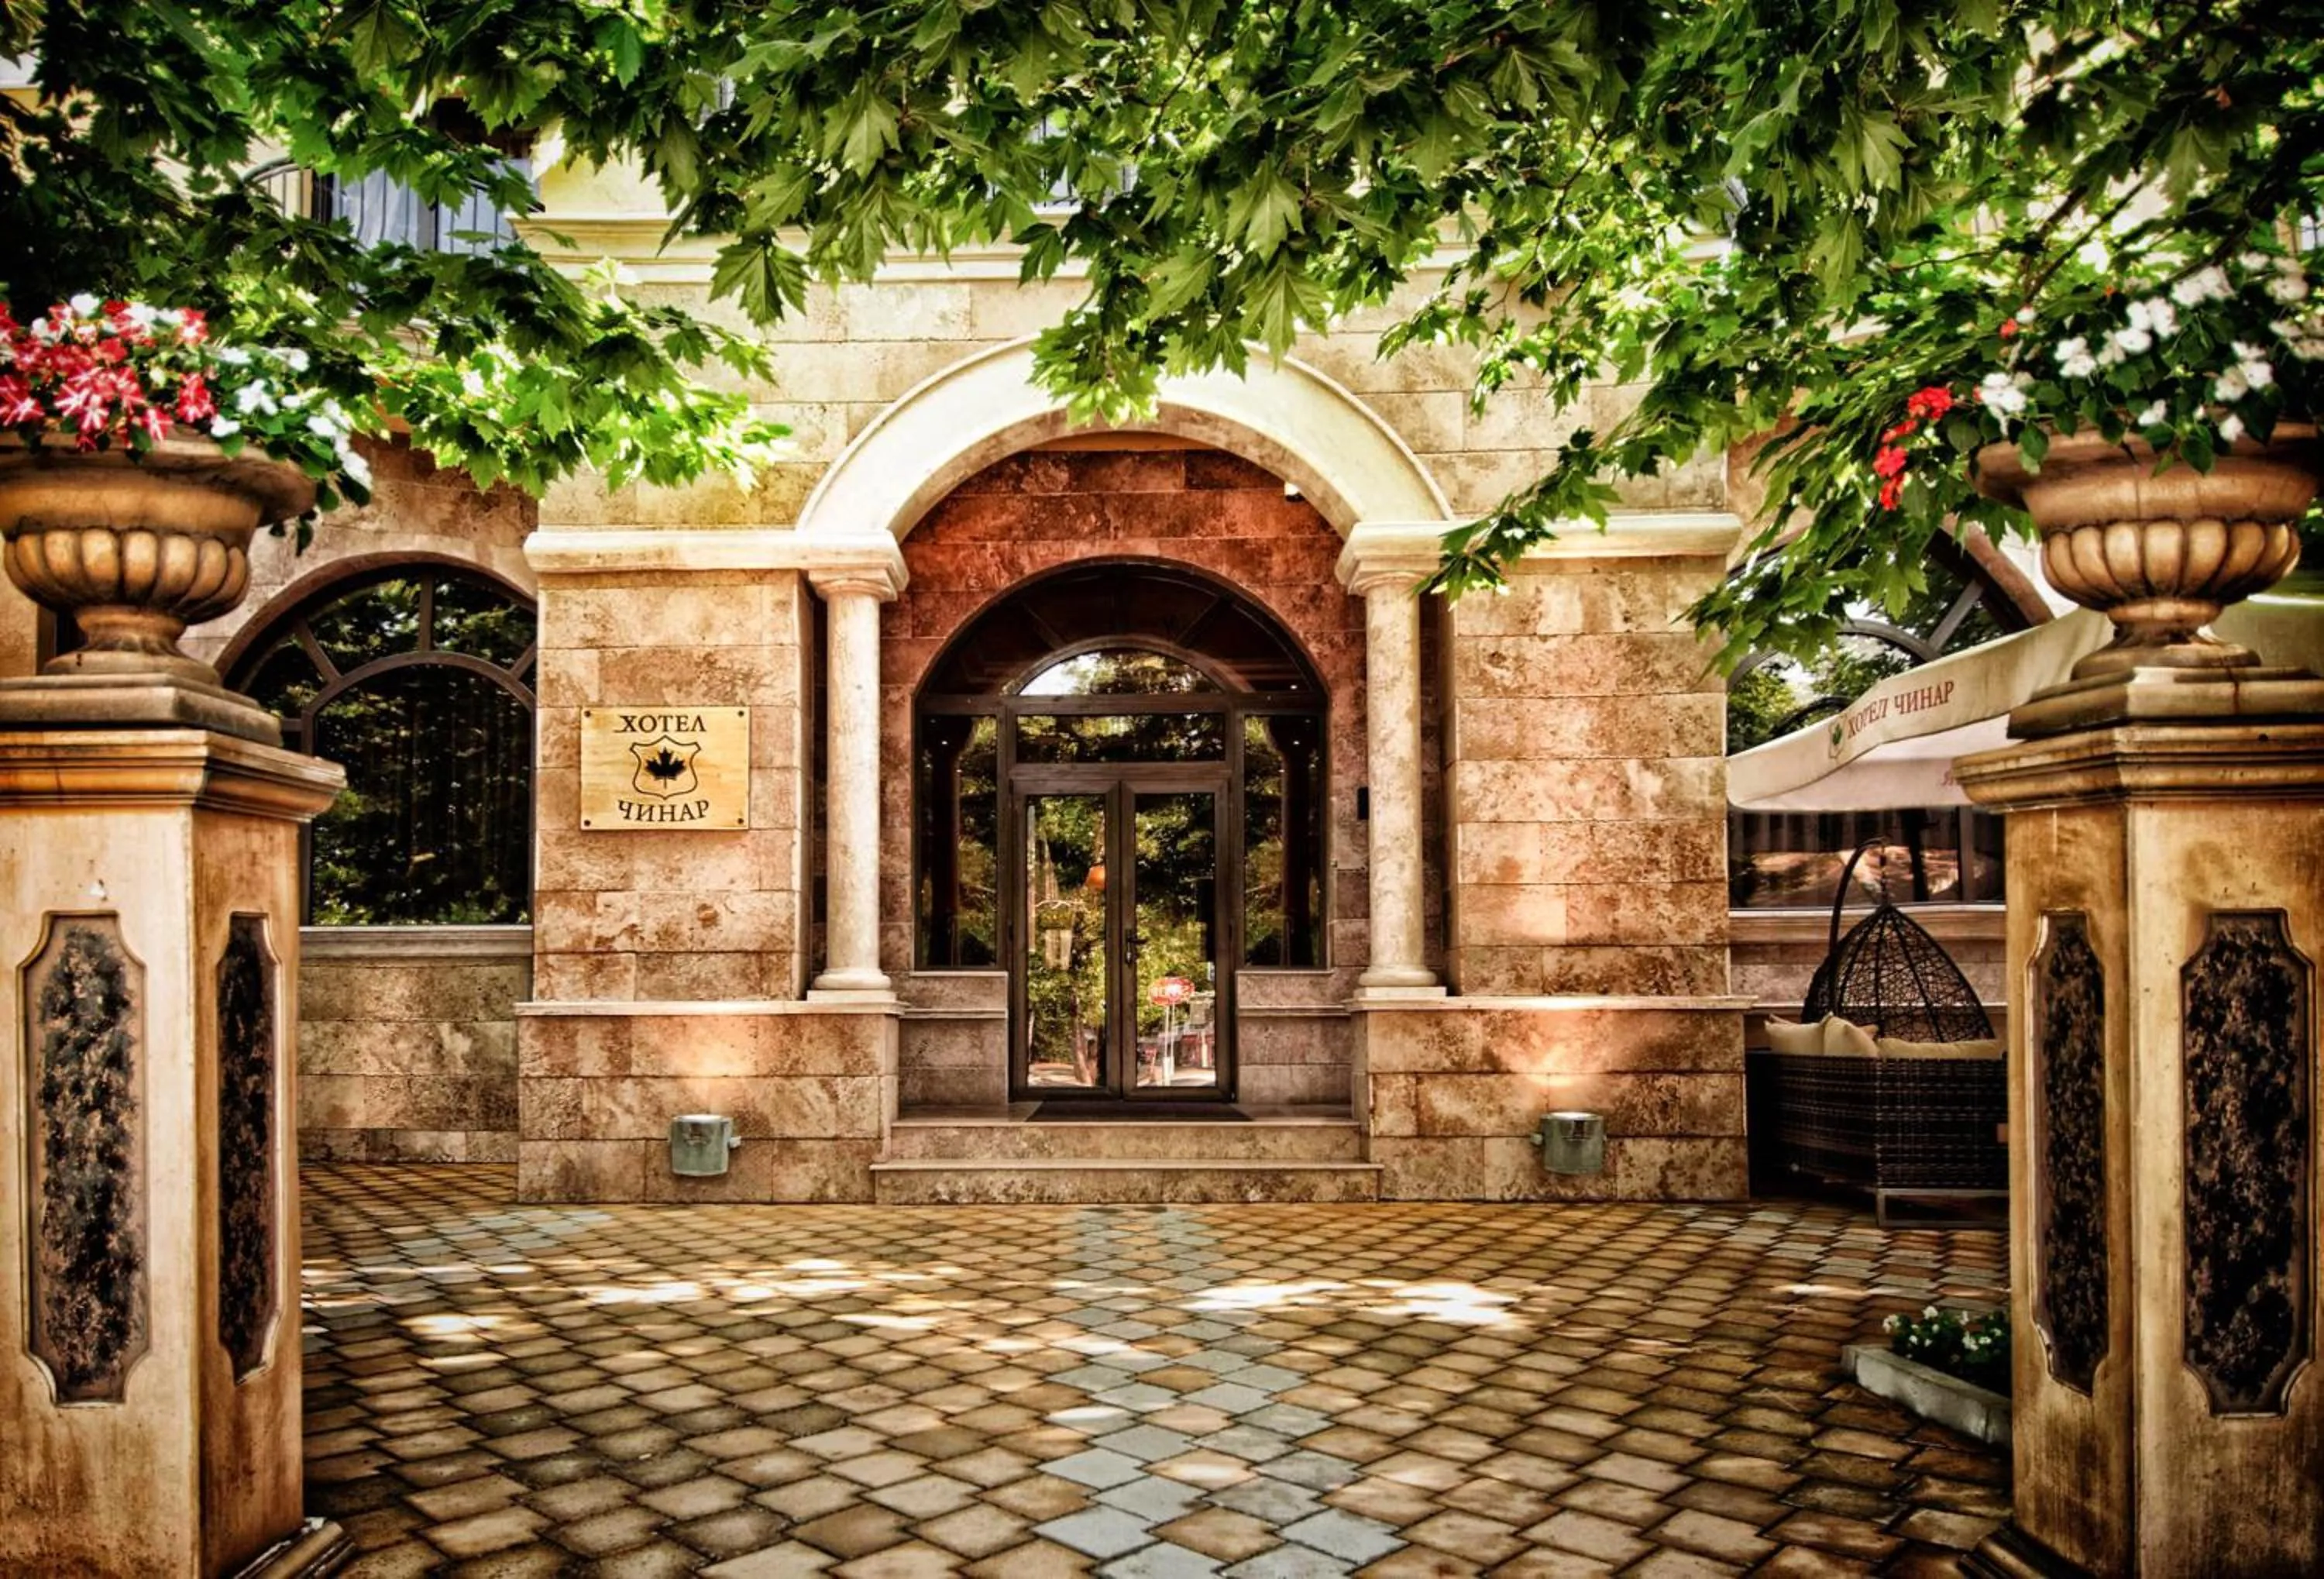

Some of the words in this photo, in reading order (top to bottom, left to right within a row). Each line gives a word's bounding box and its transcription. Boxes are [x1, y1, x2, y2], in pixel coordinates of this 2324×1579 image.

[1847, 697, 1889, 740] ХОТЕЛ
[1894, 680, 1954, 715] ЧИНАР
[614, 714, 706, 733] ХОТЕЛ
[617, 799, 710, 823] ЧИНАР
